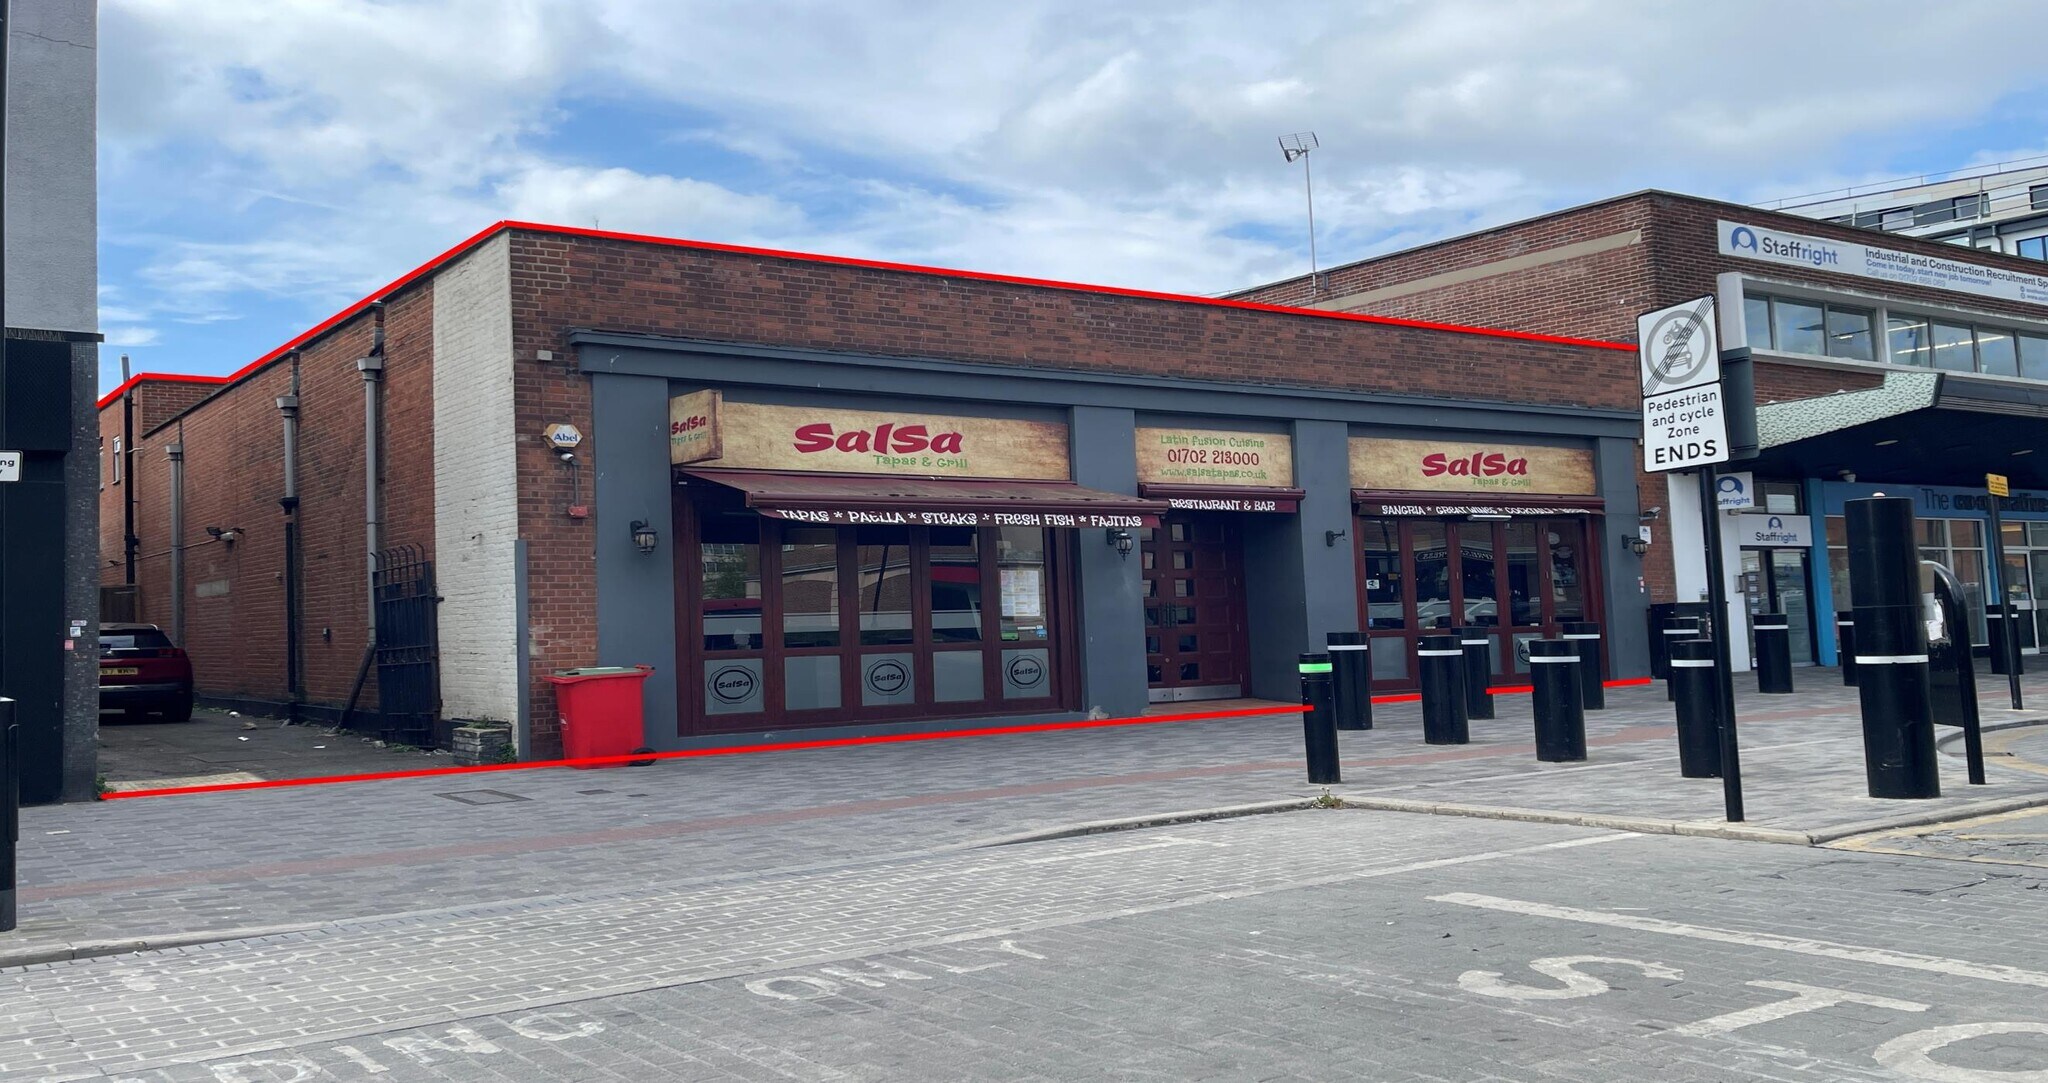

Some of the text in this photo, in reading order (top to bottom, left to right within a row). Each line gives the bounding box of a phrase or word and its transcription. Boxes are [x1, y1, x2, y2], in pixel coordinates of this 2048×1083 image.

[1762, 237, 1838, 266] Staffright
[1865, 248, 2048, 290] Industrial and Construction Recruitment Sp
[1866, 268, 1879, 276] Call
[1866, 259, 1887, 270] Come
[1889, 262, 1895, 270] in
[1917, 267, 1933, 276] start
[1948, 272, 1959, 281] job
[1960, 275, 1992, 287] tomorrow!
[1648, 392, 1717, 413] Pedestrian
[1652, 406, 1714, 427] and cycle
[553, 433, 578, 442] Abel
[1668, 426, 1700, 439] Zone
[1160, 434, 1189, 445] Latin
[1229, 437, 1265, 448] Cuisine
[1167, 448, 1260, 466] 01702 213000
[1655, 439, 1717, 464] ENDS
[873, 455, 968, 469] Tapas & Grill
[1160, 467, 1267, 480] www.salsatapas.co.uk
[1470, 477, 1532, 488] Tapas & Grill
[1168, 498, 1276, 511] RESTAURANT & BAR
[1717, 497, 1751, 506] affright
[1921, 488, 1950, 510] The
[1381, 504, 1427, 515] SANGRIA
[776, 509, 830, 522] TAPAS
[921, 512, 978, 525] STEAKS
[994, 513, 1041, 526] FRESH
[1044, 514, 1075, 526] FISH
[1090, 515, 1142, 527] FAJITAS
[1755, 531, 1798, 544] Staffright
